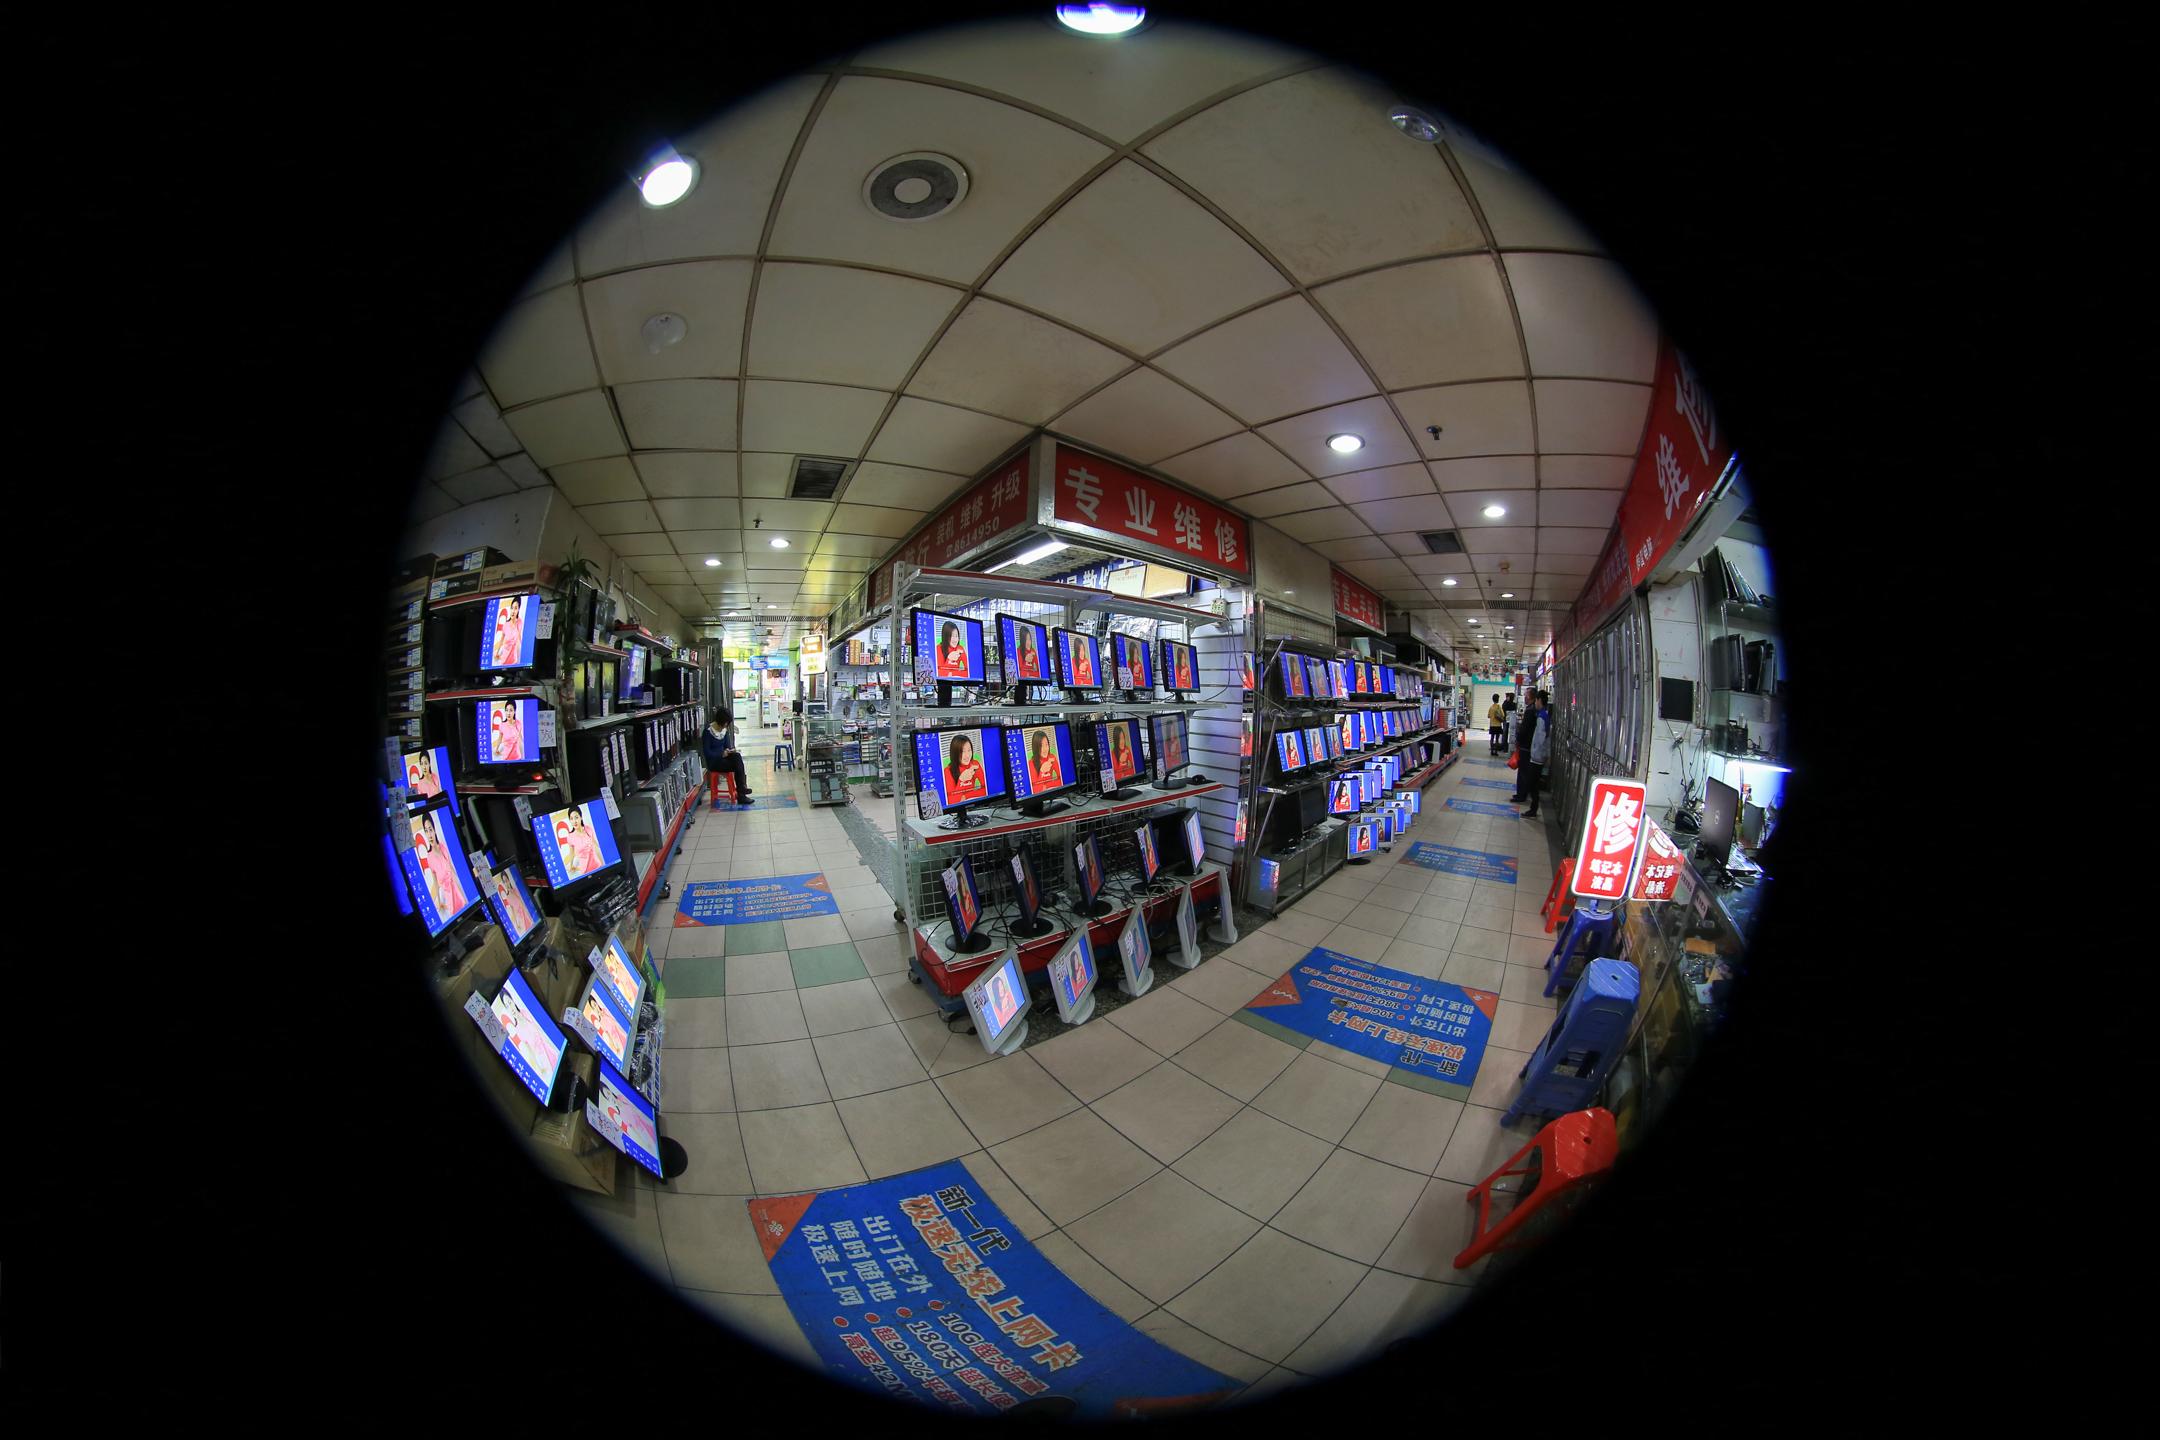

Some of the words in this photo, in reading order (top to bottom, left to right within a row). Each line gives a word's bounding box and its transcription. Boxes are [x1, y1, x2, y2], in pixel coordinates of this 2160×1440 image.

[960, 496, 984, 529] 维修
[991, 471, 1020, 511] 升级
[1064, 466, 1239, 563] 专业维修
[954, 516, 1000, 553] 8614950
[1593, 791, 1640, 855] 修
[1589, 858, 1624, 876] 笔记本
[1590, 875, 1614, 891] 液晶
[1410, 1015, 1467, 1038] 出门在外
[1421, 993, 1475, 1014] 极速上网
[1326, 1008, 1467, 1061] 极速无线上网卡
[1399, 1048, 1459, 1077] 新一代
[936, 1184, 1013, 1256] 新一代
[801, 1223, 864, 1307] 极速上网
[829, 1219, 897, 1303] 随时随地
[861, 1215, 933, 1295] 出门在外
[899, 1193, 1084, 1372] 极速无线上网卡
